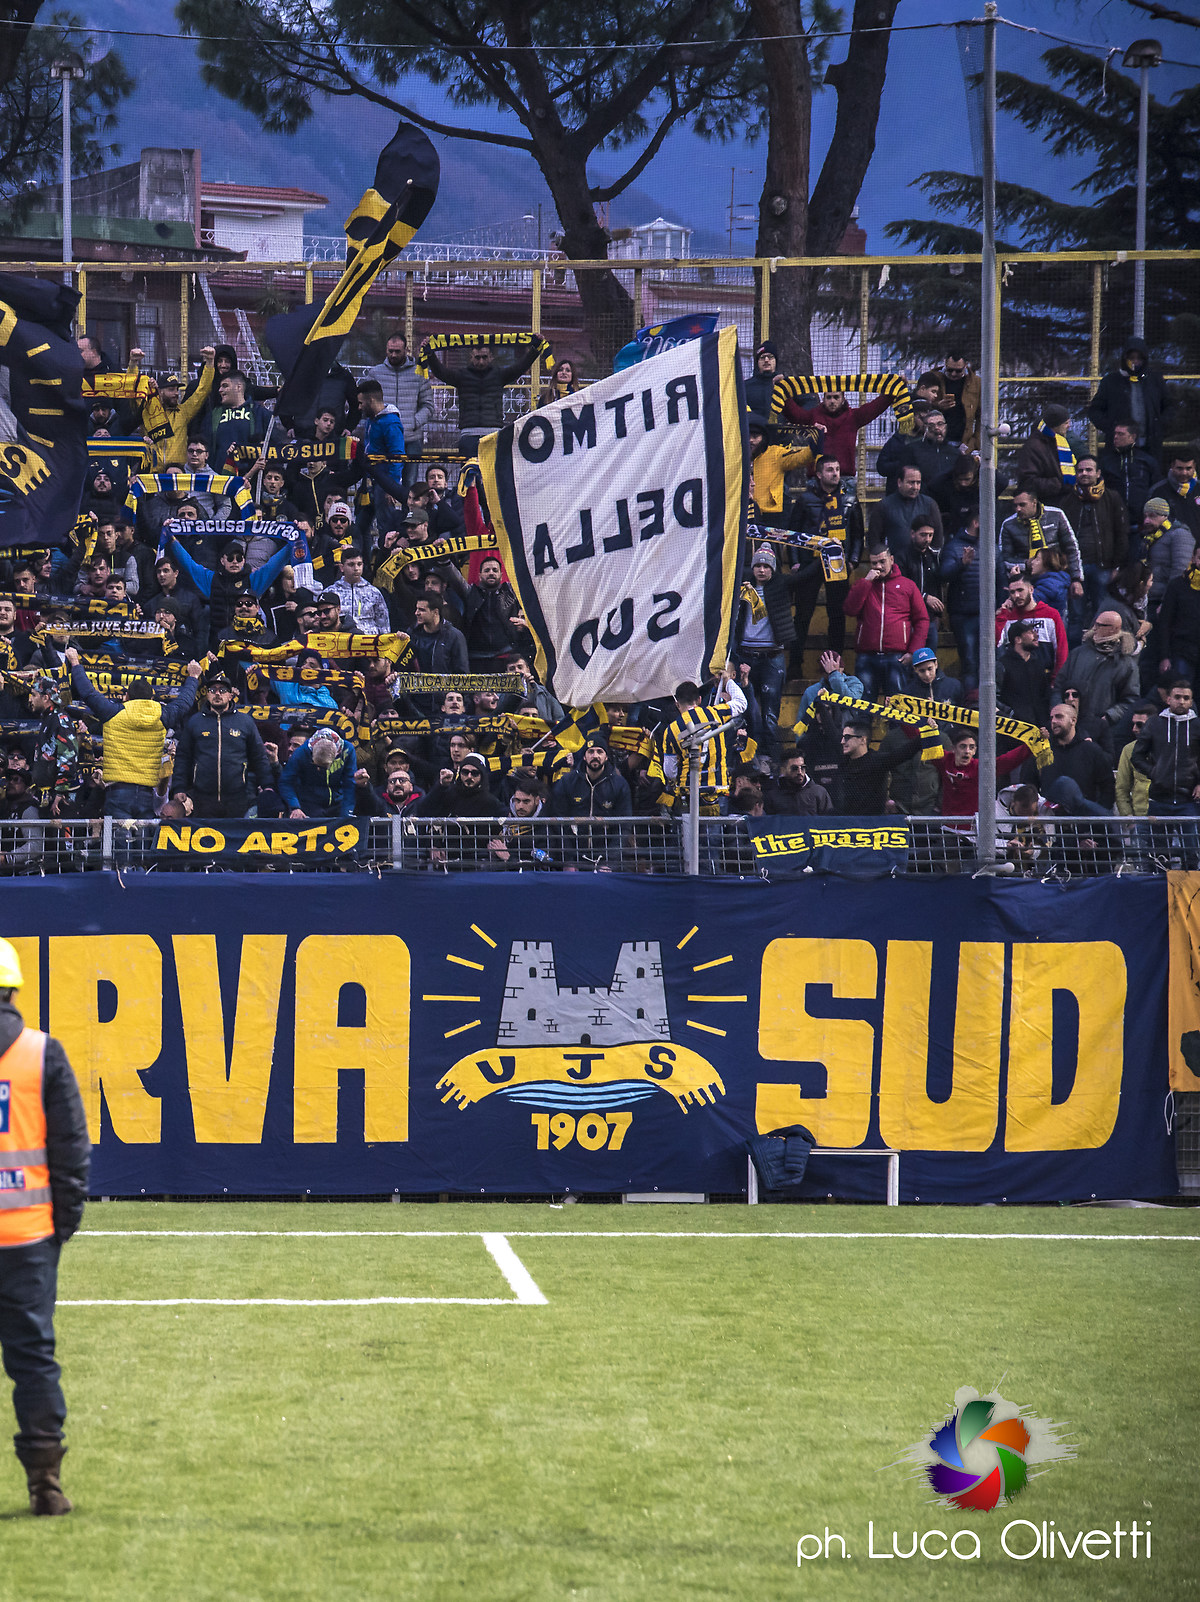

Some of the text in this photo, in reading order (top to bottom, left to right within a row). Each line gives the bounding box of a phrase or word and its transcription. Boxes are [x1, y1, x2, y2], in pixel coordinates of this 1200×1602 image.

[429, 332, 534, 350] MARTINS
[301, 442, 336, 458] SUD
[170, 518, 245, 533] Siracusa
[251, 520, 300, 541] Ultras
[478, 532, 498, 548] 19
[91, 620, 121, 632] JUVE
[401, 675, 445, 688] MITICA
[823, 690, 921, 725] MARTINS
[156, 824, 360, 855] NO ART.9
[751, 829, 907, 854] the wasps
[755, 937, 1129, 1154] SUD
[531, 1112, 633, 1152] 1907
